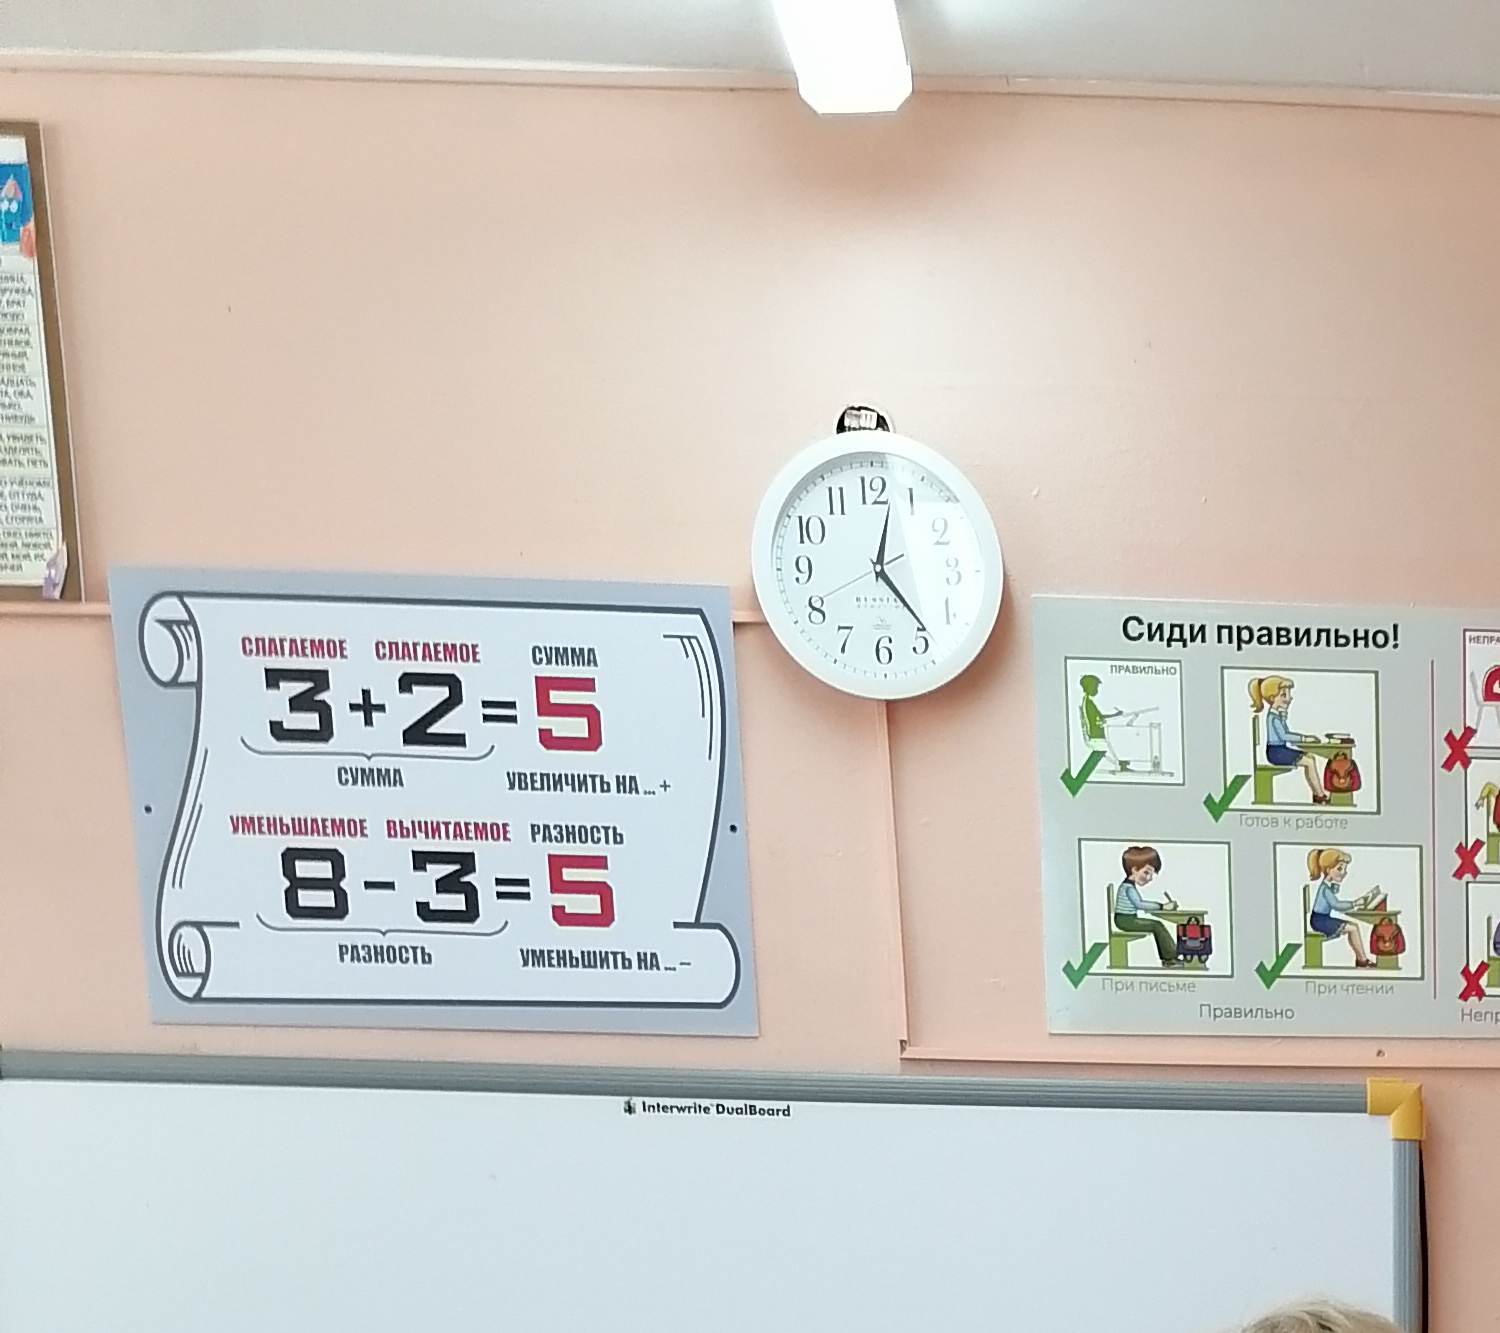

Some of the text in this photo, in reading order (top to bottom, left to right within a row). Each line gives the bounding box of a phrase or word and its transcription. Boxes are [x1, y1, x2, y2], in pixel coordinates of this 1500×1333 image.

[827, 486, 847, 516] 11
[859, 475, 890, 506] 12
[906, 487, 915, 516] 1
[797, 515, 827, 545] 10
[931, 516, 951, 546] 2
[794, 555, 813, 585] 9
[945, 557, 963, 586] 3
[807, 595, 827, 625] 8
[836, 624, 855, 655] 7
[911, 627, 930, 656] 5
[1121, 614, 1401, 654] Сиди правильно!
[241, 635, 600, 669] СЛАГАЕМОЕ СЛАГАЕМОЕ СУММА
[874, 635, 894, 666] 6
[1109, 664, 1178, 677] ПРАВИЛЬНО
[337, 765, 406, 789] СУММА
[506, 770, 612, 794] УВЕЛИЧИТЬ
[615, 774, 640, 795] НА
[229, 814, 625, 846] УМЕНЬШАЕМОЕ ВЫЧИТАЕМОЕ РАЗНОСТЬ
[1238, 813, 1349, 832] Готов к работе
[338, 942, 434, 966] РАЗНОСТЬ
[519, 947, 633, 971] УМЕНЬШИТЬ
[636, 951, 661, 972] НА
[1101, 978, 1197, 995] При письме
[1305, 980, 1395, 997] При чтении
[1198, 1002, 1296, 1023] Правильно
[715, 1103, 792, 1118] DualBoard
